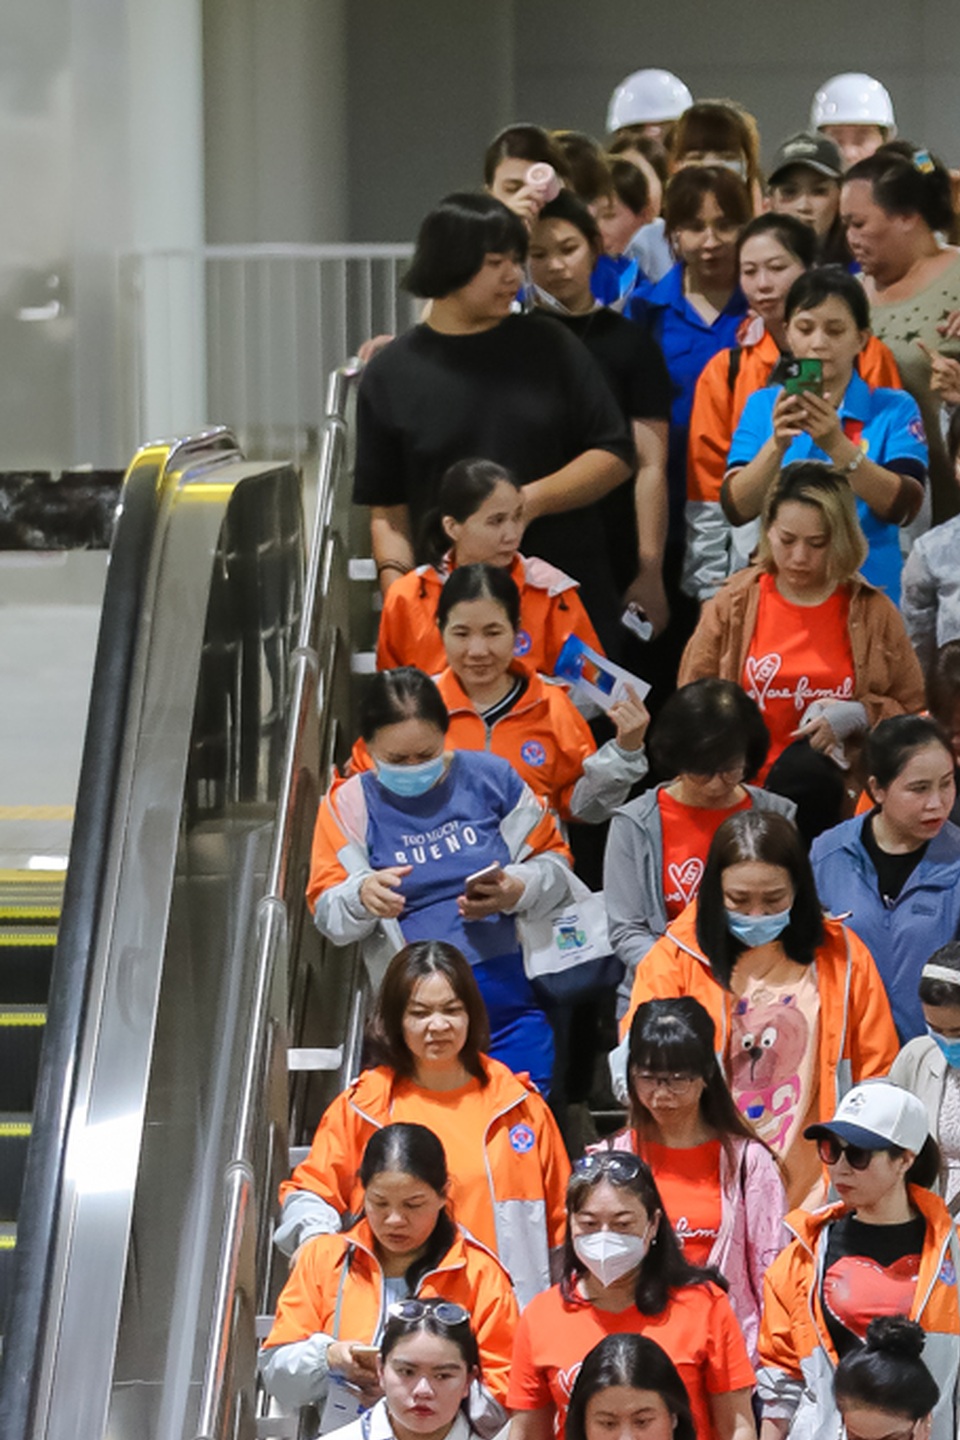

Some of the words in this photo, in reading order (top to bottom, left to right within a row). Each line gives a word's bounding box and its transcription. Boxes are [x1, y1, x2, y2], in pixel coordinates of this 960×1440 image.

[794, 676, 852, 710] famil
[395, 827, 477, 864] BUENO
[401, 834, 426, 847] TOO
[426, 820, 459, 842] MUCH
